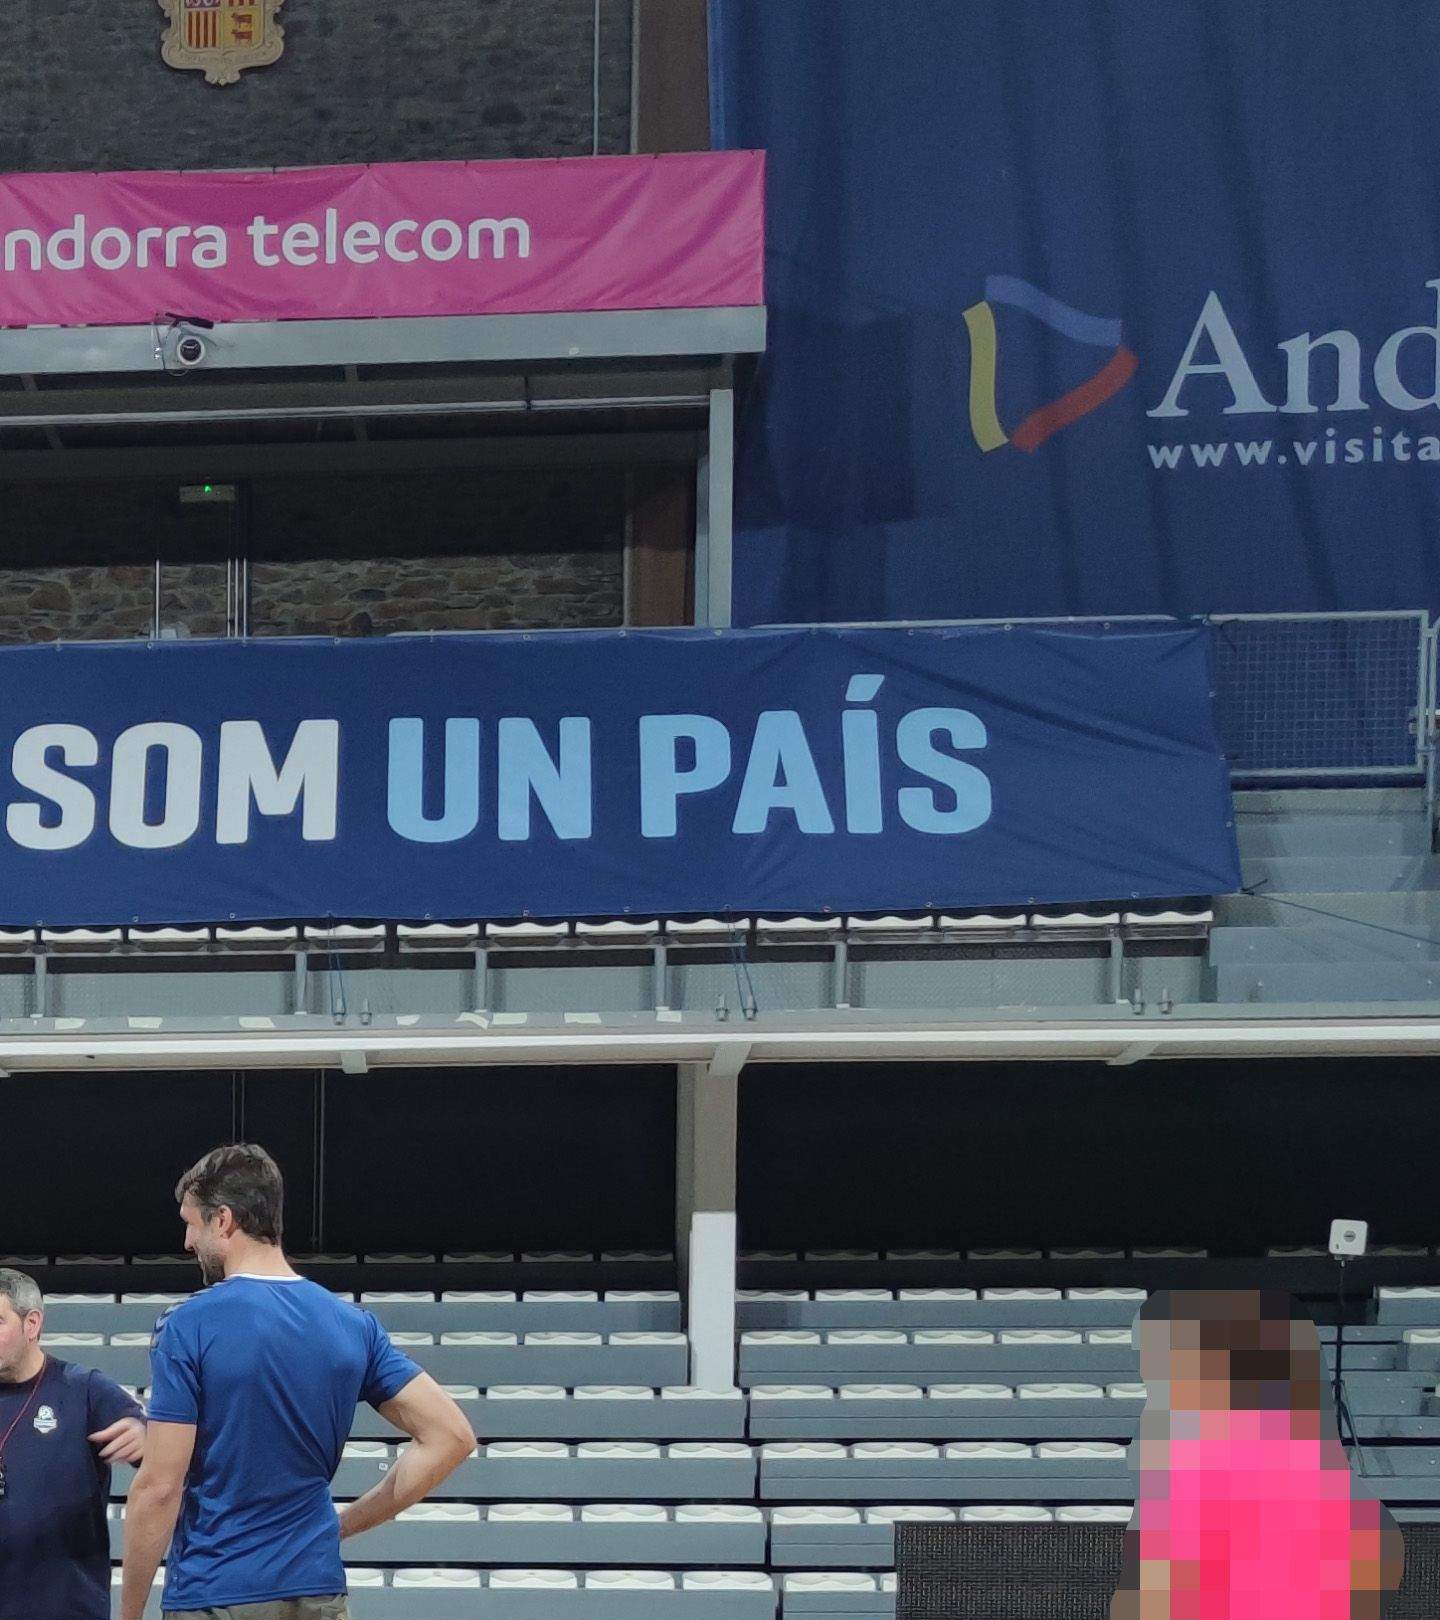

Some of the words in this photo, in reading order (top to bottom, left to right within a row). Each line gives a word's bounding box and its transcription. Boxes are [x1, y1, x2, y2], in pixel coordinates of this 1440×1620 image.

[247, 207, 530, 267] telecom
[5, 717, 339, 851] SOM
[386, 715, 592, 843] UN
[637, 673, 994, 839] PAÍS
